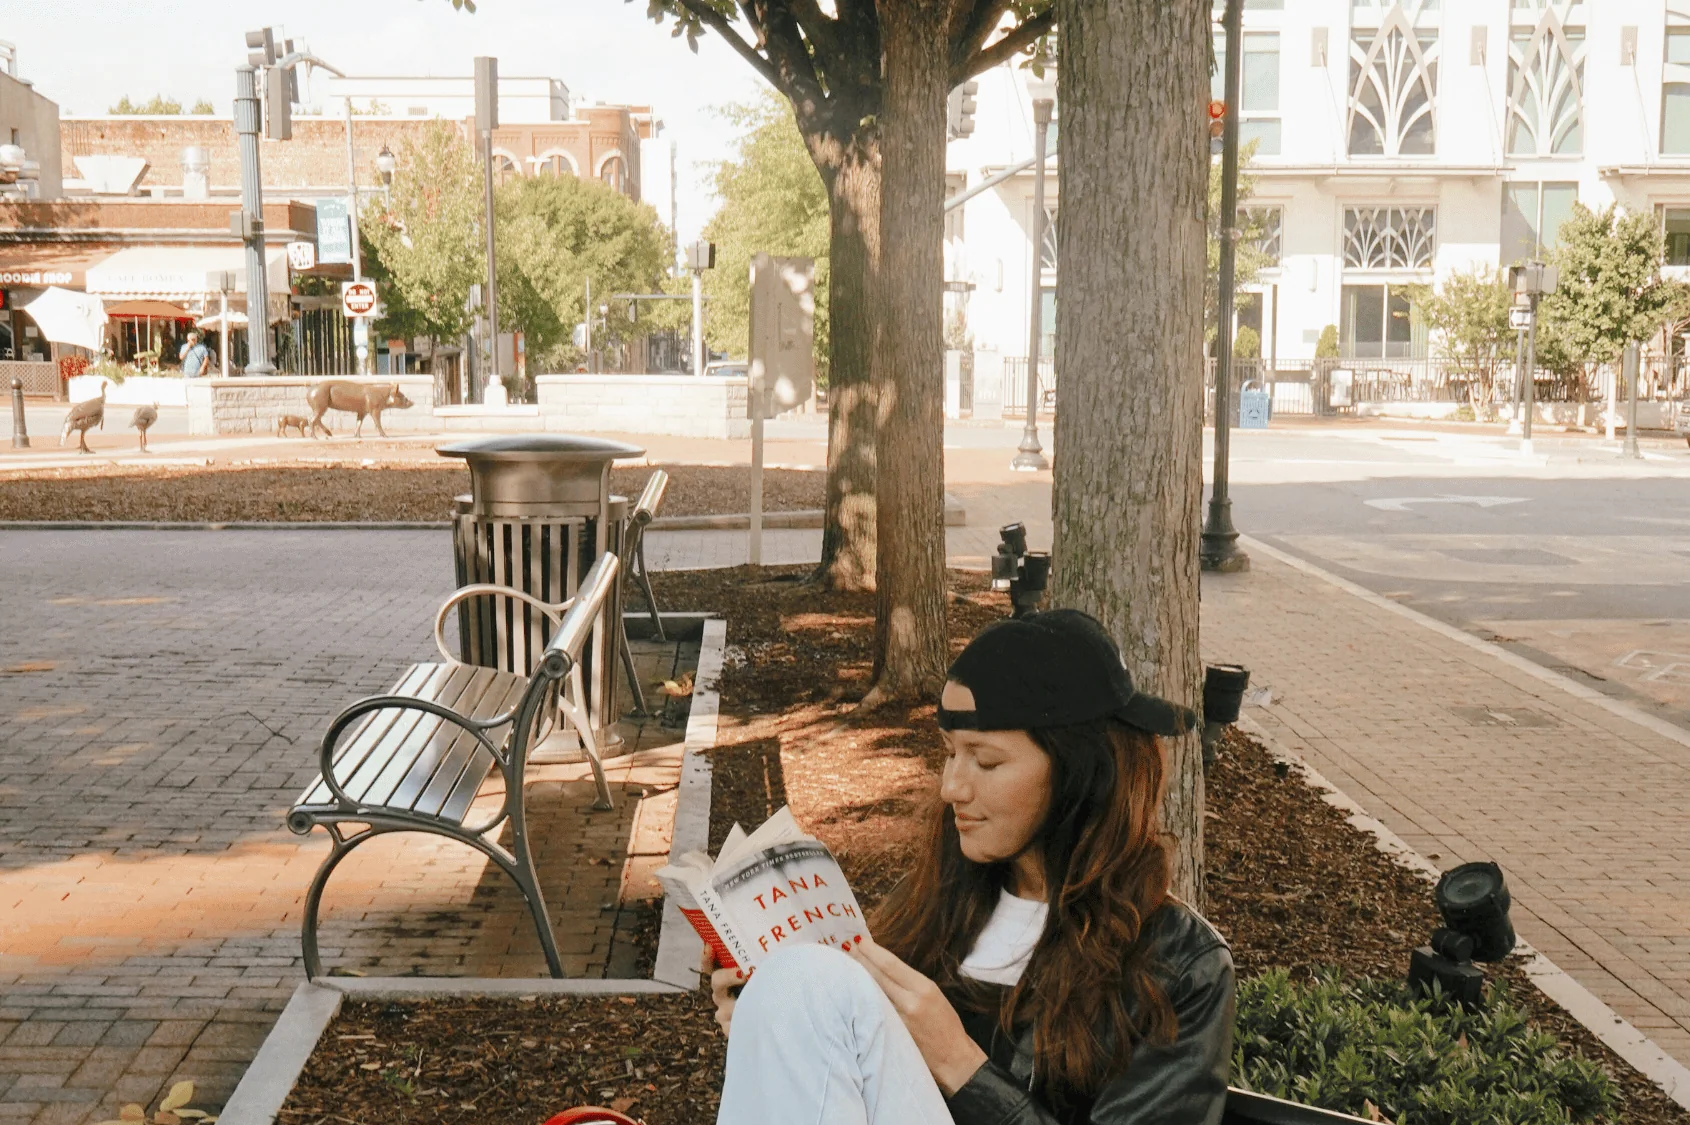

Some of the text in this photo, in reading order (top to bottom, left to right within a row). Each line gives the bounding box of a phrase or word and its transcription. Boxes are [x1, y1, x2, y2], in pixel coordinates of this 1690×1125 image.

[43, 272, 73, 284] SHOP
[724, 877, 740, 890] NEW
[741, 866, 760, 880] YORK
[761, 855, 784, 869] TIMES
[753, 873, 828, 910] TANA
[700, 890, 721, 919] TANA
[721, 922, 751, 963] FRENCH
[758, 903, 857, 953] FRENCH
